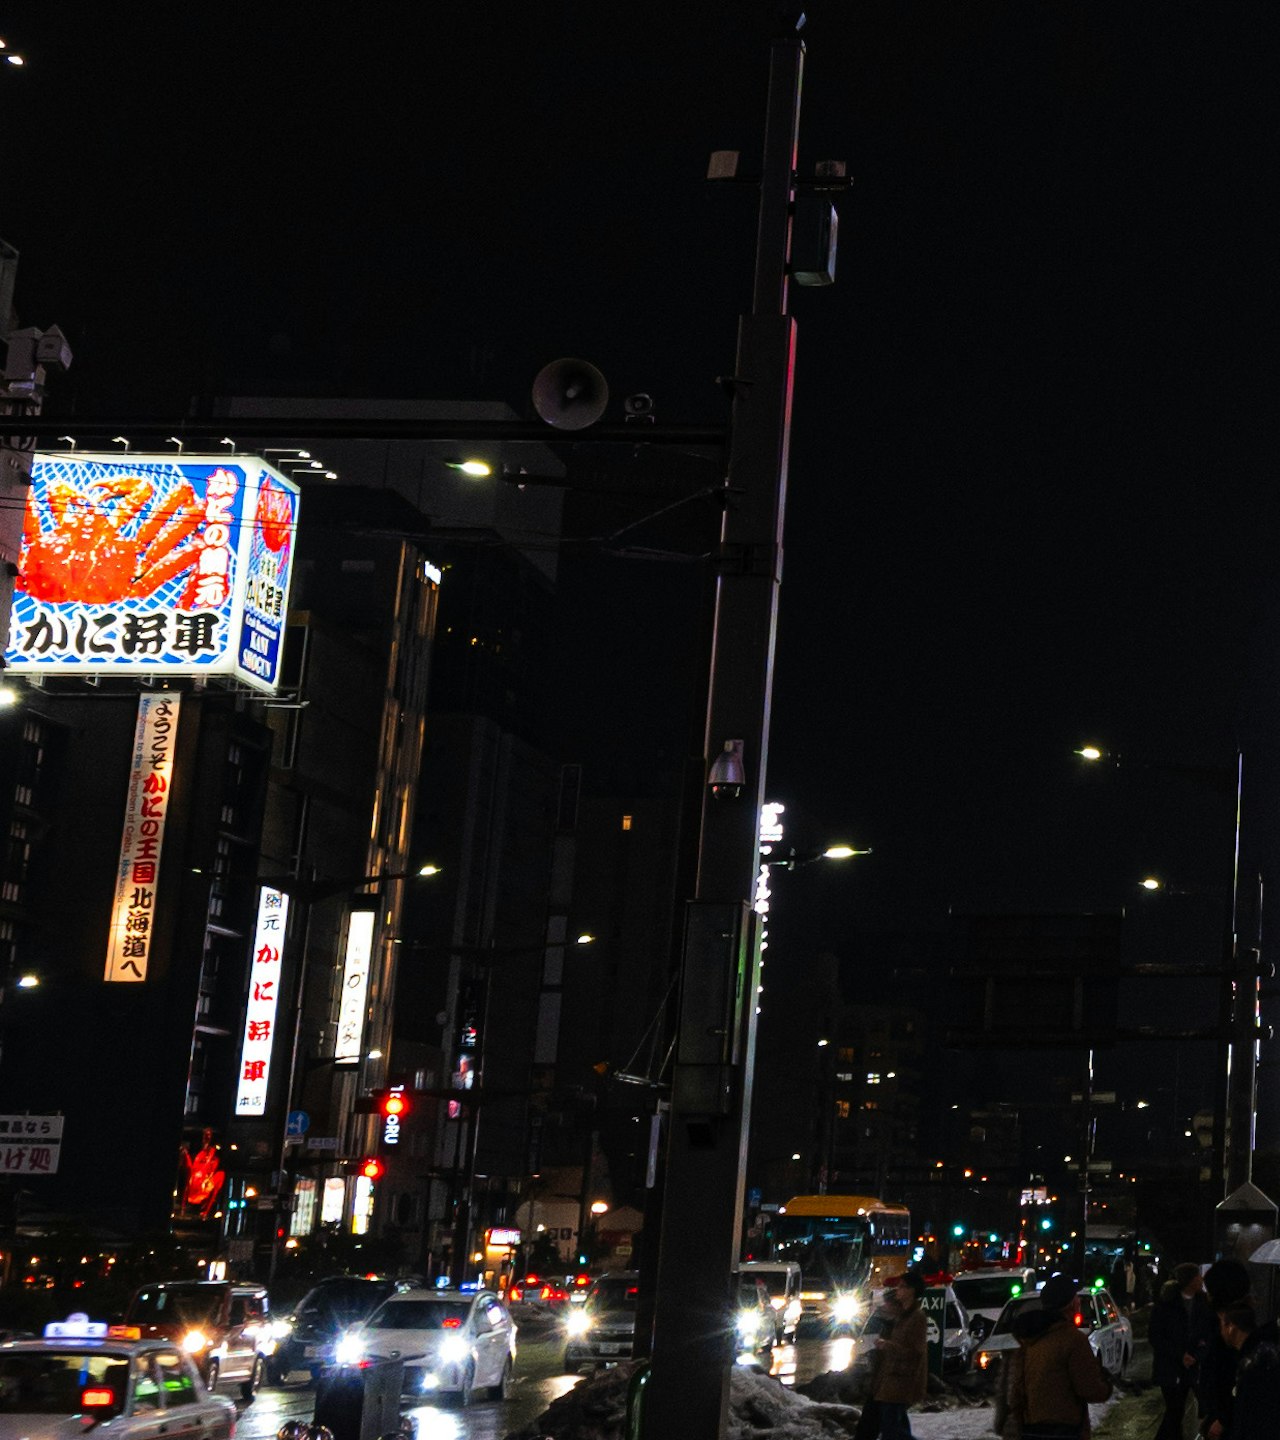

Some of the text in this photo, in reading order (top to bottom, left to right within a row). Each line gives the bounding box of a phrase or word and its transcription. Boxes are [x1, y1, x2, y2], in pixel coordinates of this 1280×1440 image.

[22, 611, 220, 655] かに将軍
[242, 943, 280, 1083] かに将軍
[0, 1147, 50, 1171] げ処
